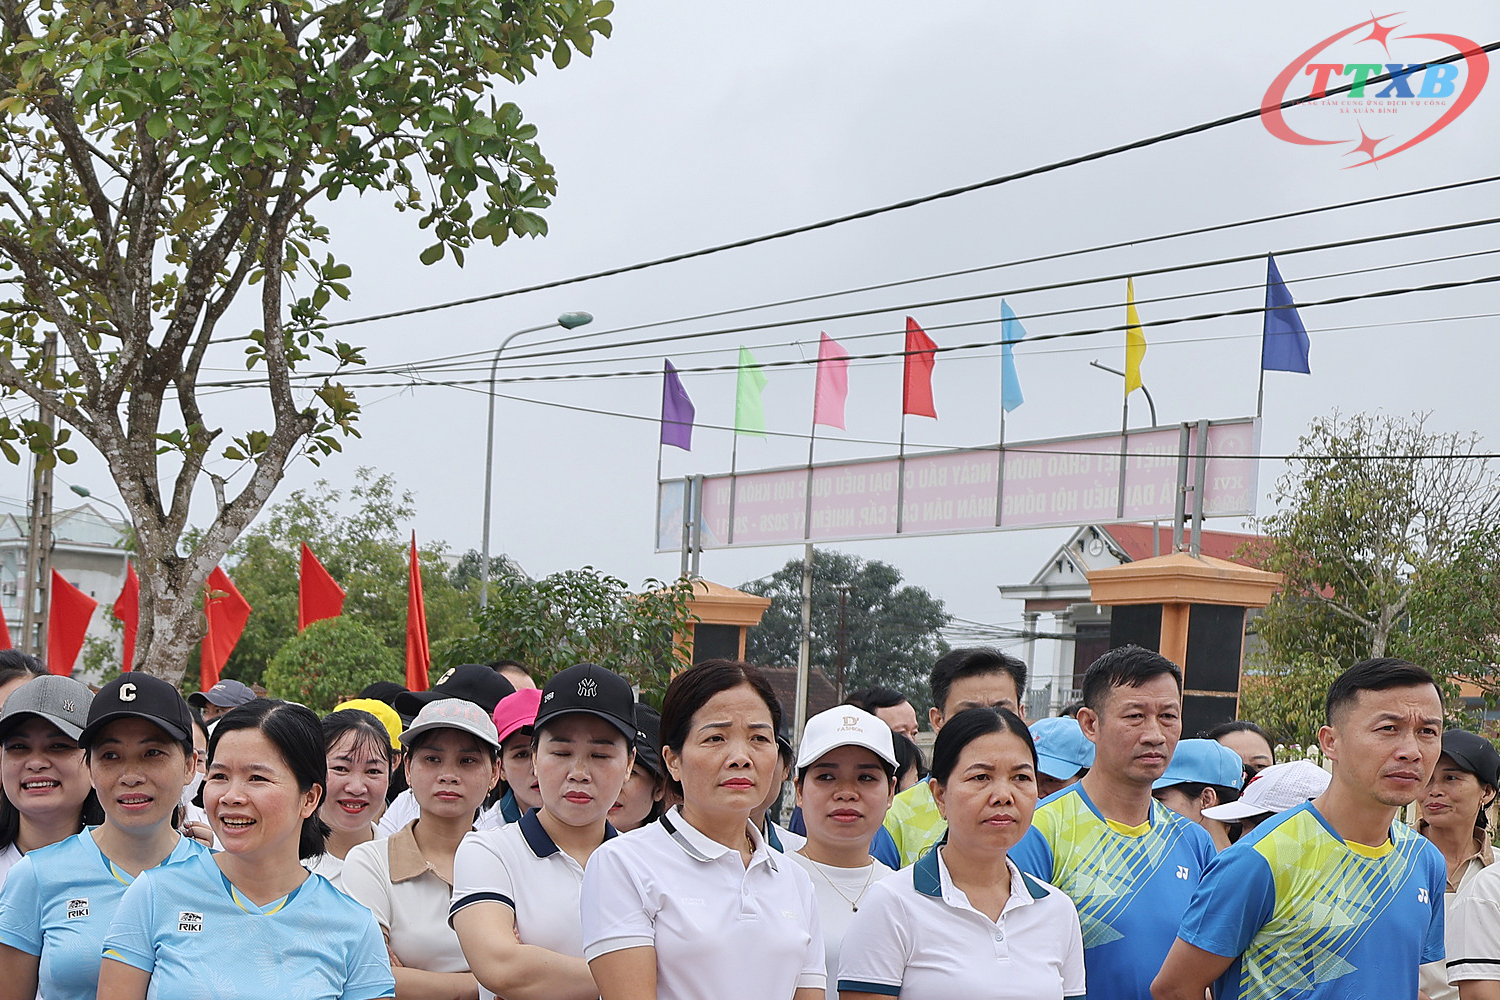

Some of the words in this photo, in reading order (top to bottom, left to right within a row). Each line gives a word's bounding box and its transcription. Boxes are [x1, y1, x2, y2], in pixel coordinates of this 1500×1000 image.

[119, 682, 137, 702] C
[67, 908, 89, 918] RIKI
[179, 923, 202, 931] RIKI
